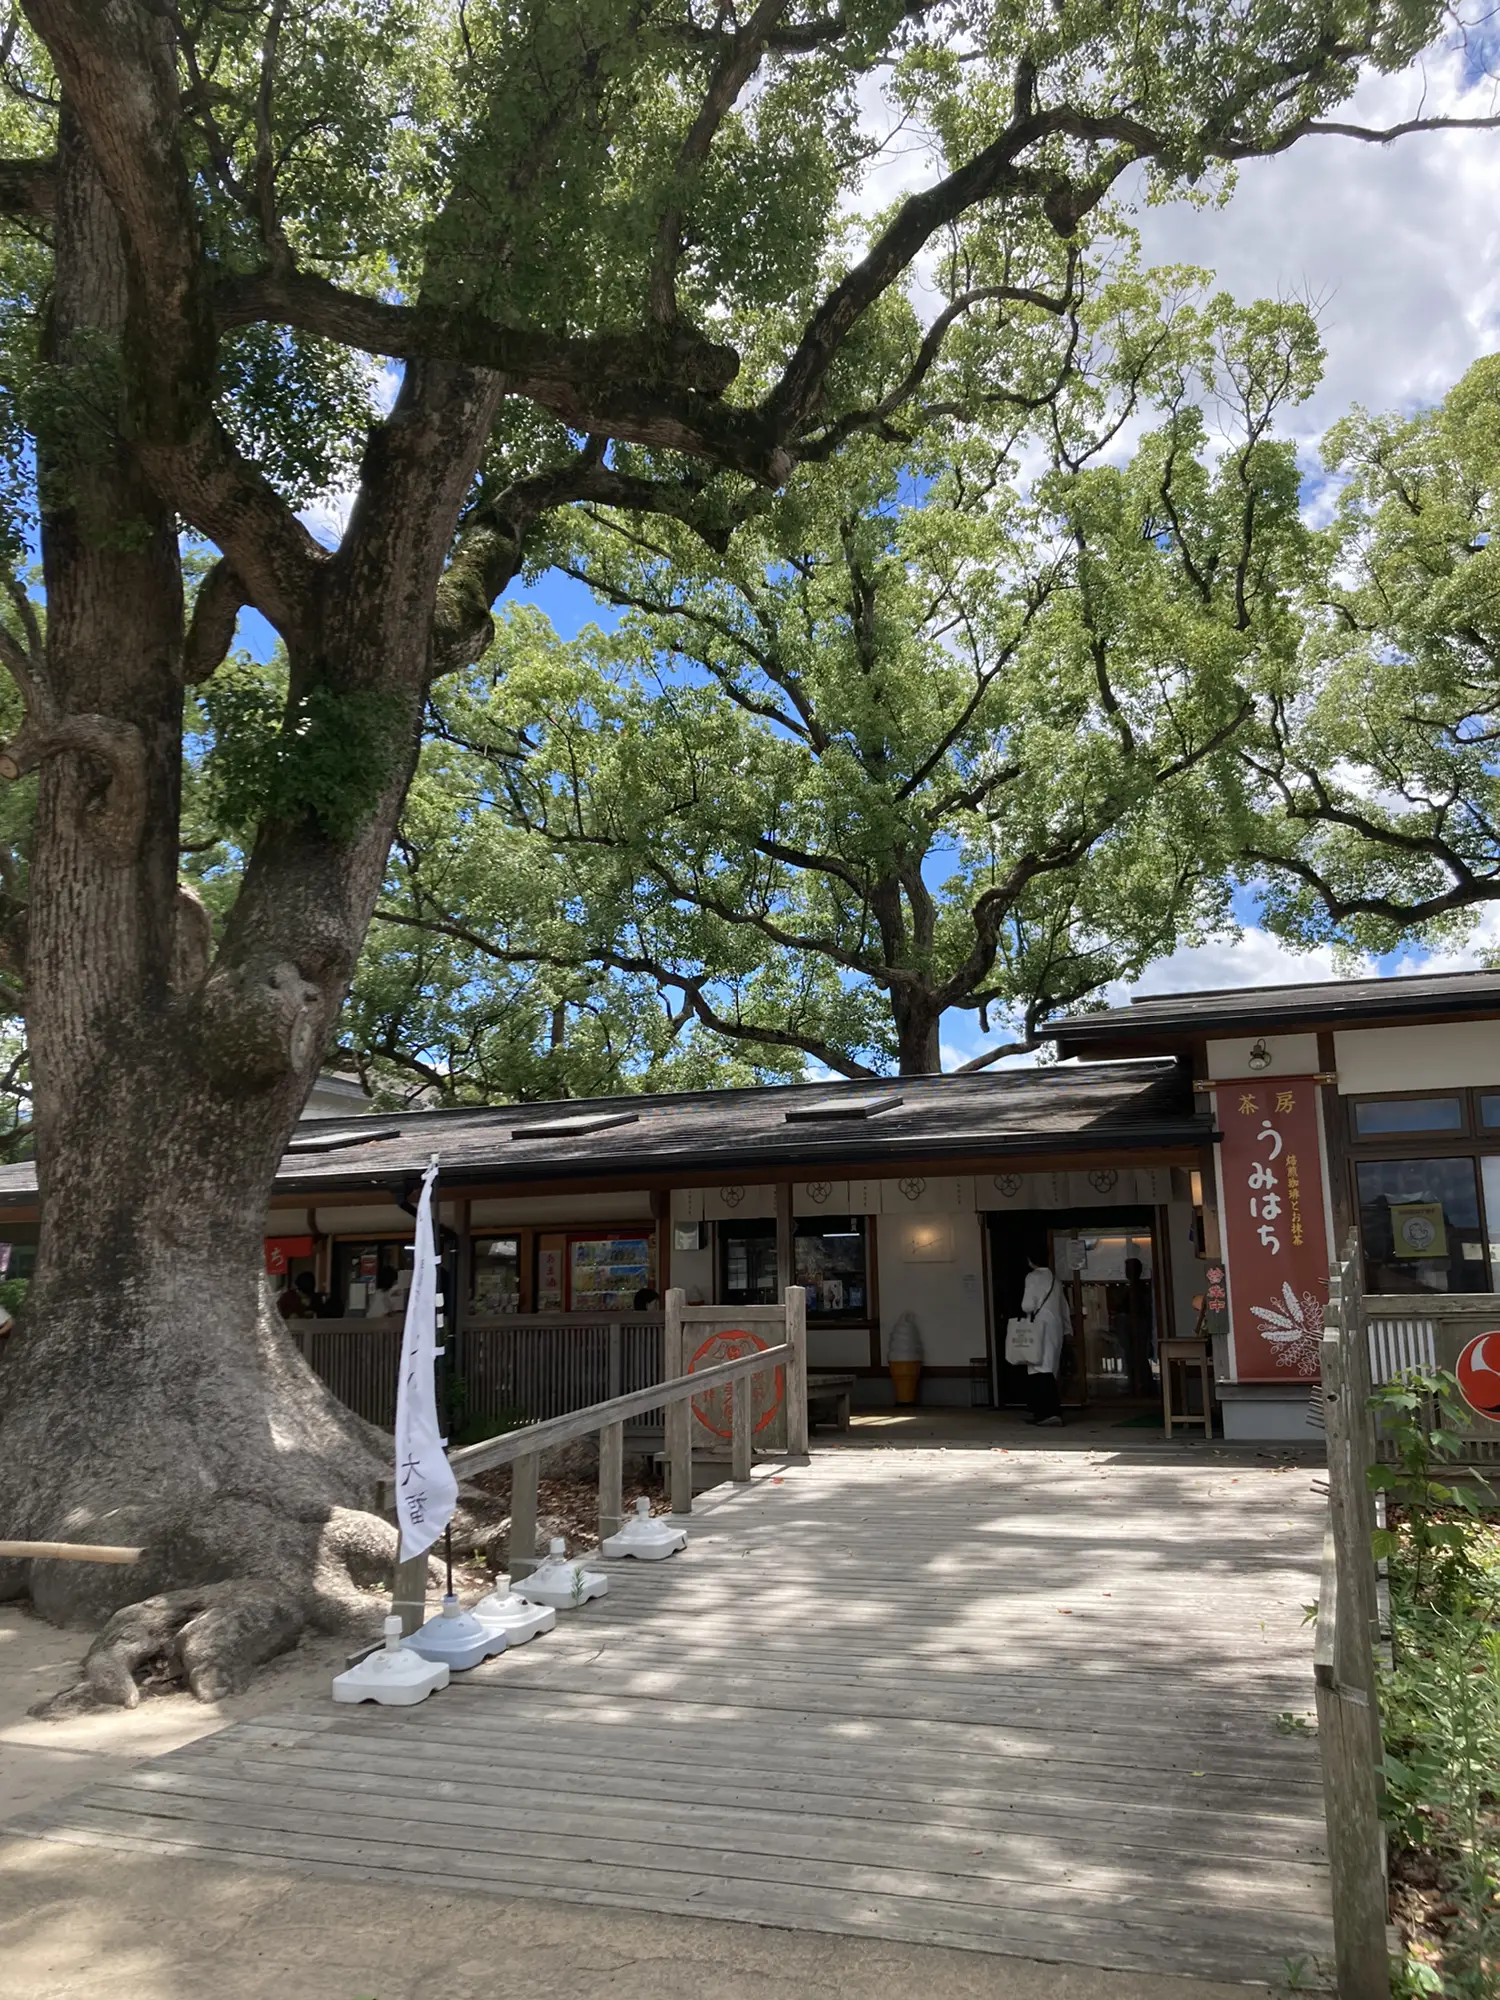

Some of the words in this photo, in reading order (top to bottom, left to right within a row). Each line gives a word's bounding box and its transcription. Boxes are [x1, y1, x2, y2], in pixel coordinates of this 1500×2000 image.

[1238, 1090, 1296, 1114] 茶房
[1248, 1120, 1282, 1255] うみはち
[1285, 1154, 1303, 1246] 焙煎珈琲とお抹茶
[1206, 1267, 1226, 1313] 営業中
